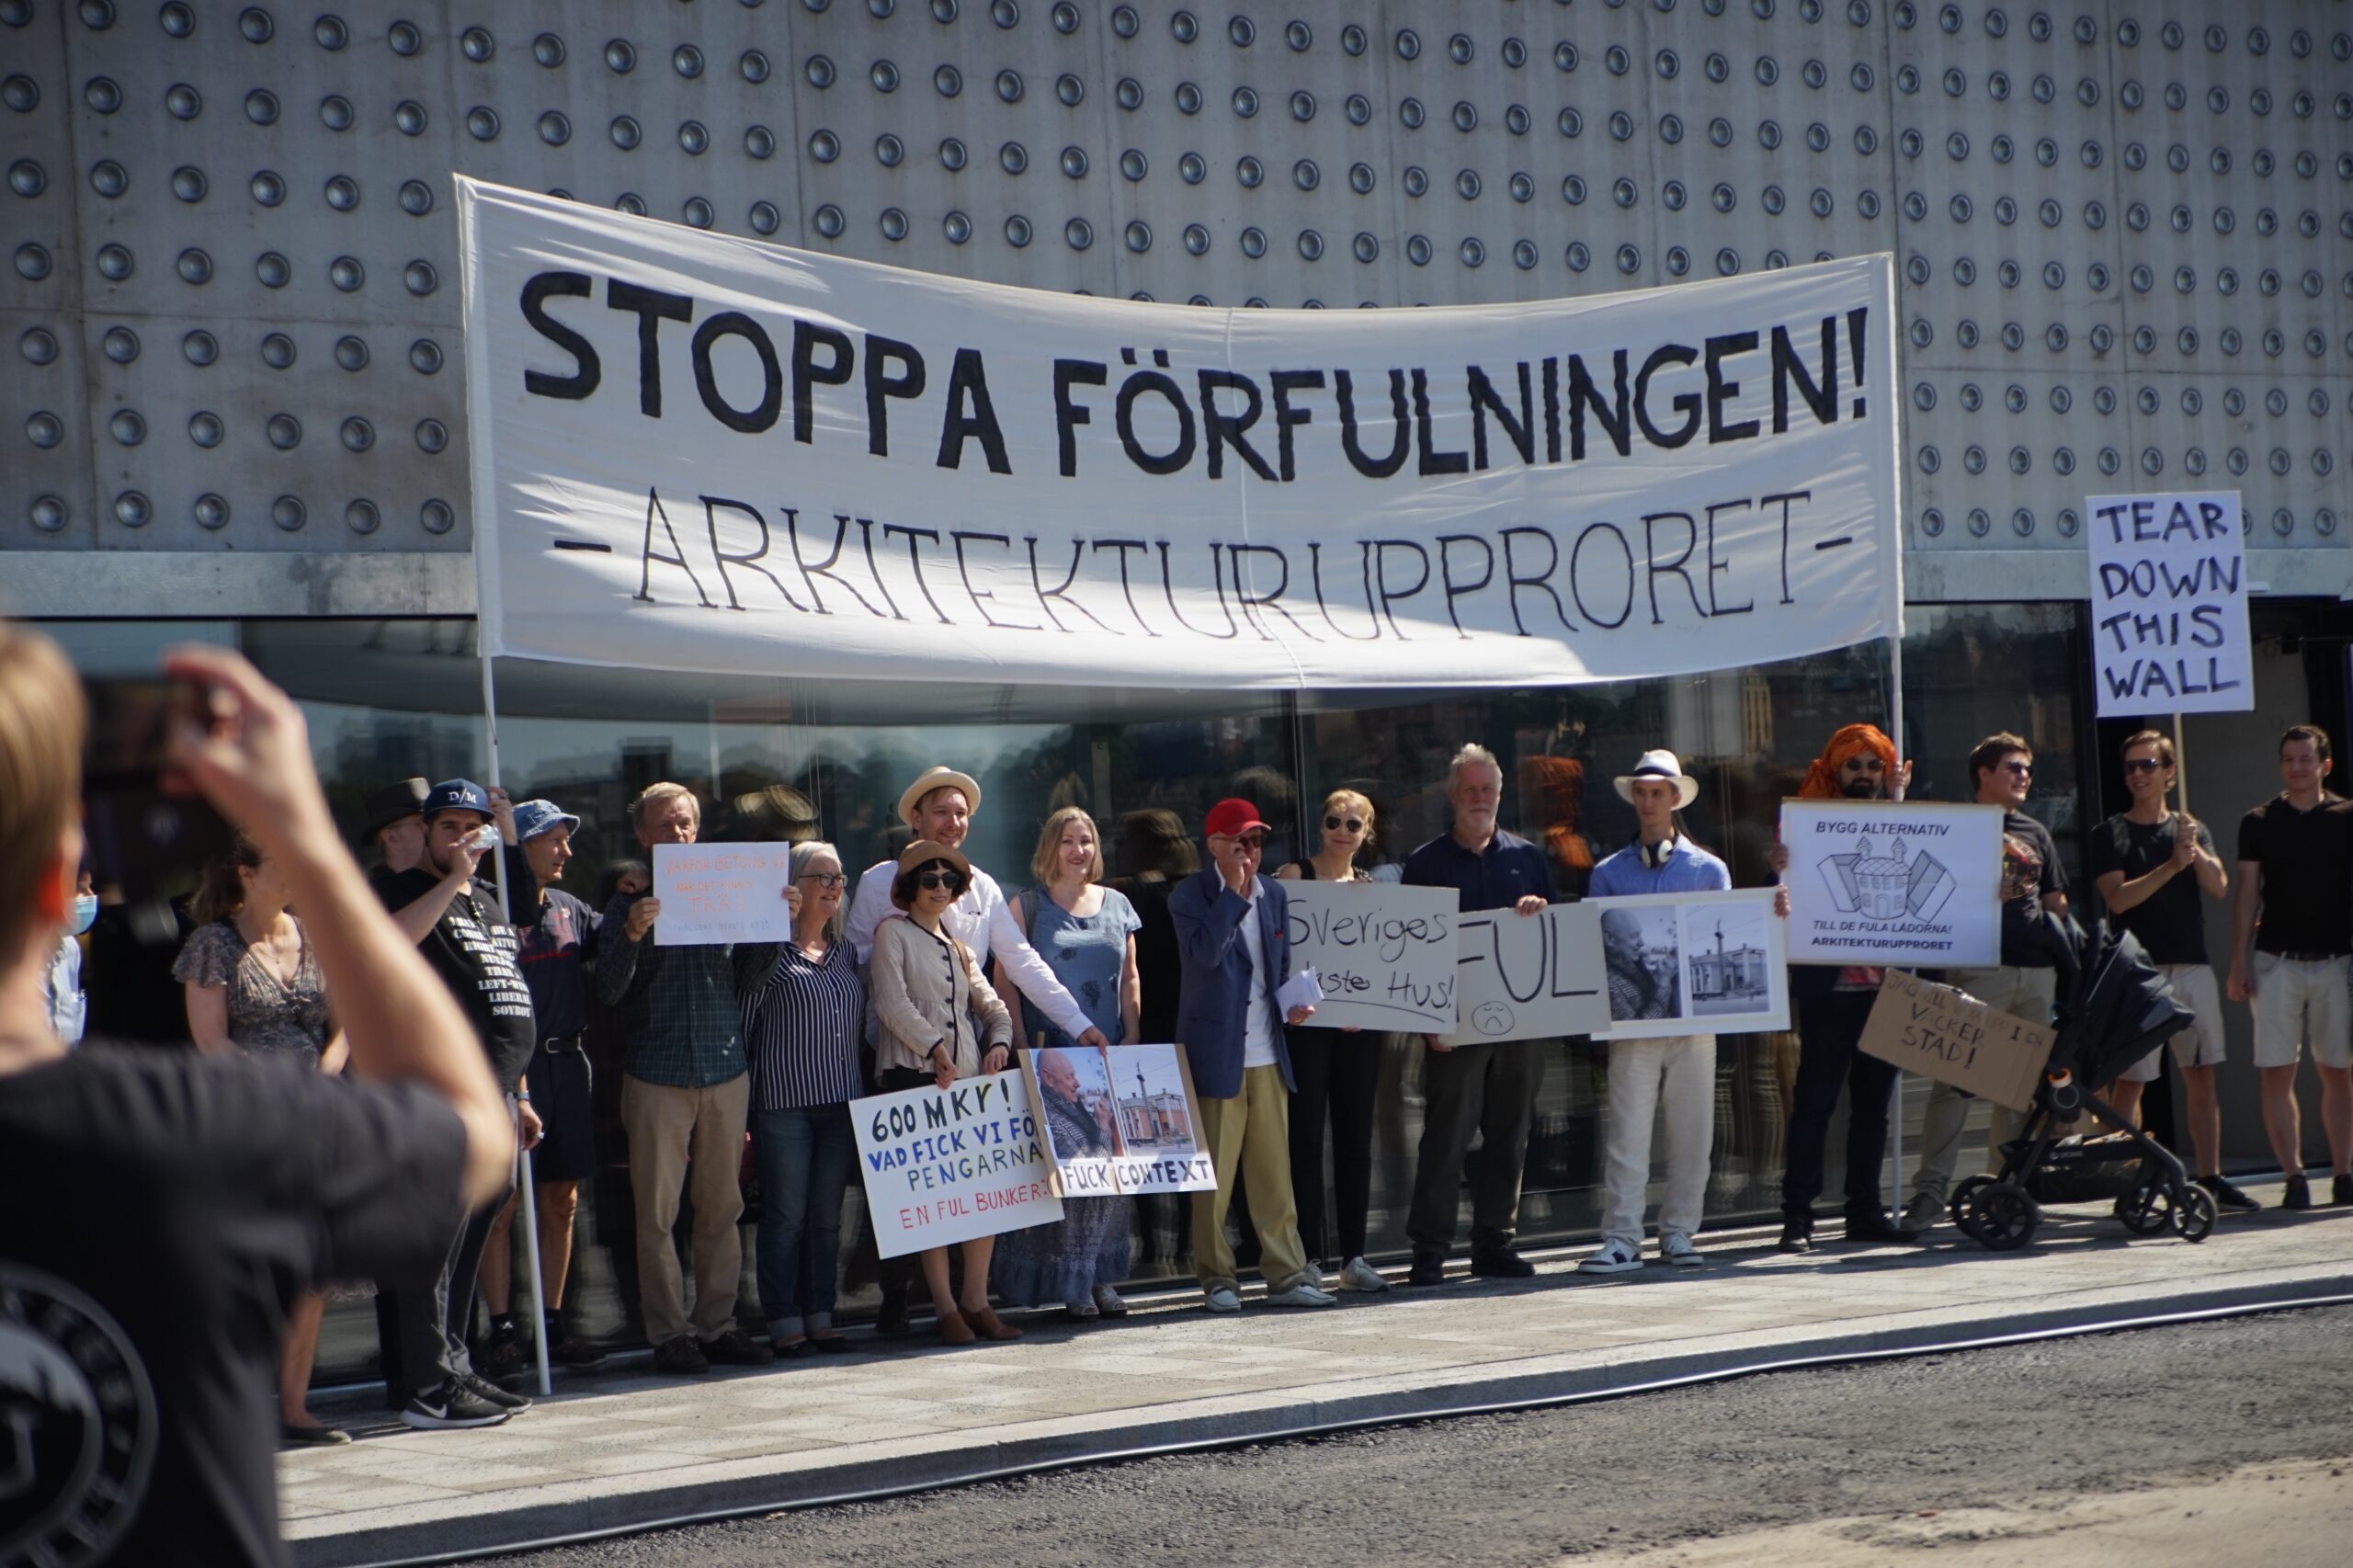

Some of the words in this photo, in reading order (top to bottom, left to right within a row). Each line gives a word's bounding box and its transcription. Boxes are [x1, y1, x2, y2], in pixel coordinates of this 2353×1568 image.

[520, 270, 1012, 475] STOPPA
[1053, 306, 1869, 483] FÖRFULNINGEN!
[2096, 501, 2229, 544] TEAR
[2099, 555, 2241, 600] DOWN
[2100, 604, 2224, 653] THIS
[2104, 656, 2241, 700] WALL
[1815, 822, 1858, 834] BYGG
[1860, 824, 1949, 836] ALTERNATIV
[1812, 937, 1954, 950] ARKITEKTURUPPRORET
[1813, 920, 1836, 930] TILL
[1840, 921, 1856, 930] DE
[1859, 922, 1889, 932] FULA
[867, 1146, 907, 1172] VAD
[912, 1129, 968, 1165] FICK
[972, 1121, 1004, 1146] VI
[1008, 1108, 1040, 1142] FÖ
[871, 1104, 916, 1142] 600
[906, 1141, 1044, 1192] PENGARNA
[1063, 1163, 1109, 1190] FUCK
[1118, 1159, 1209, 1187] CONTEXT
[899, 1204, 930, 1230] EN
[937, 1198, 970, 1221] FUL
